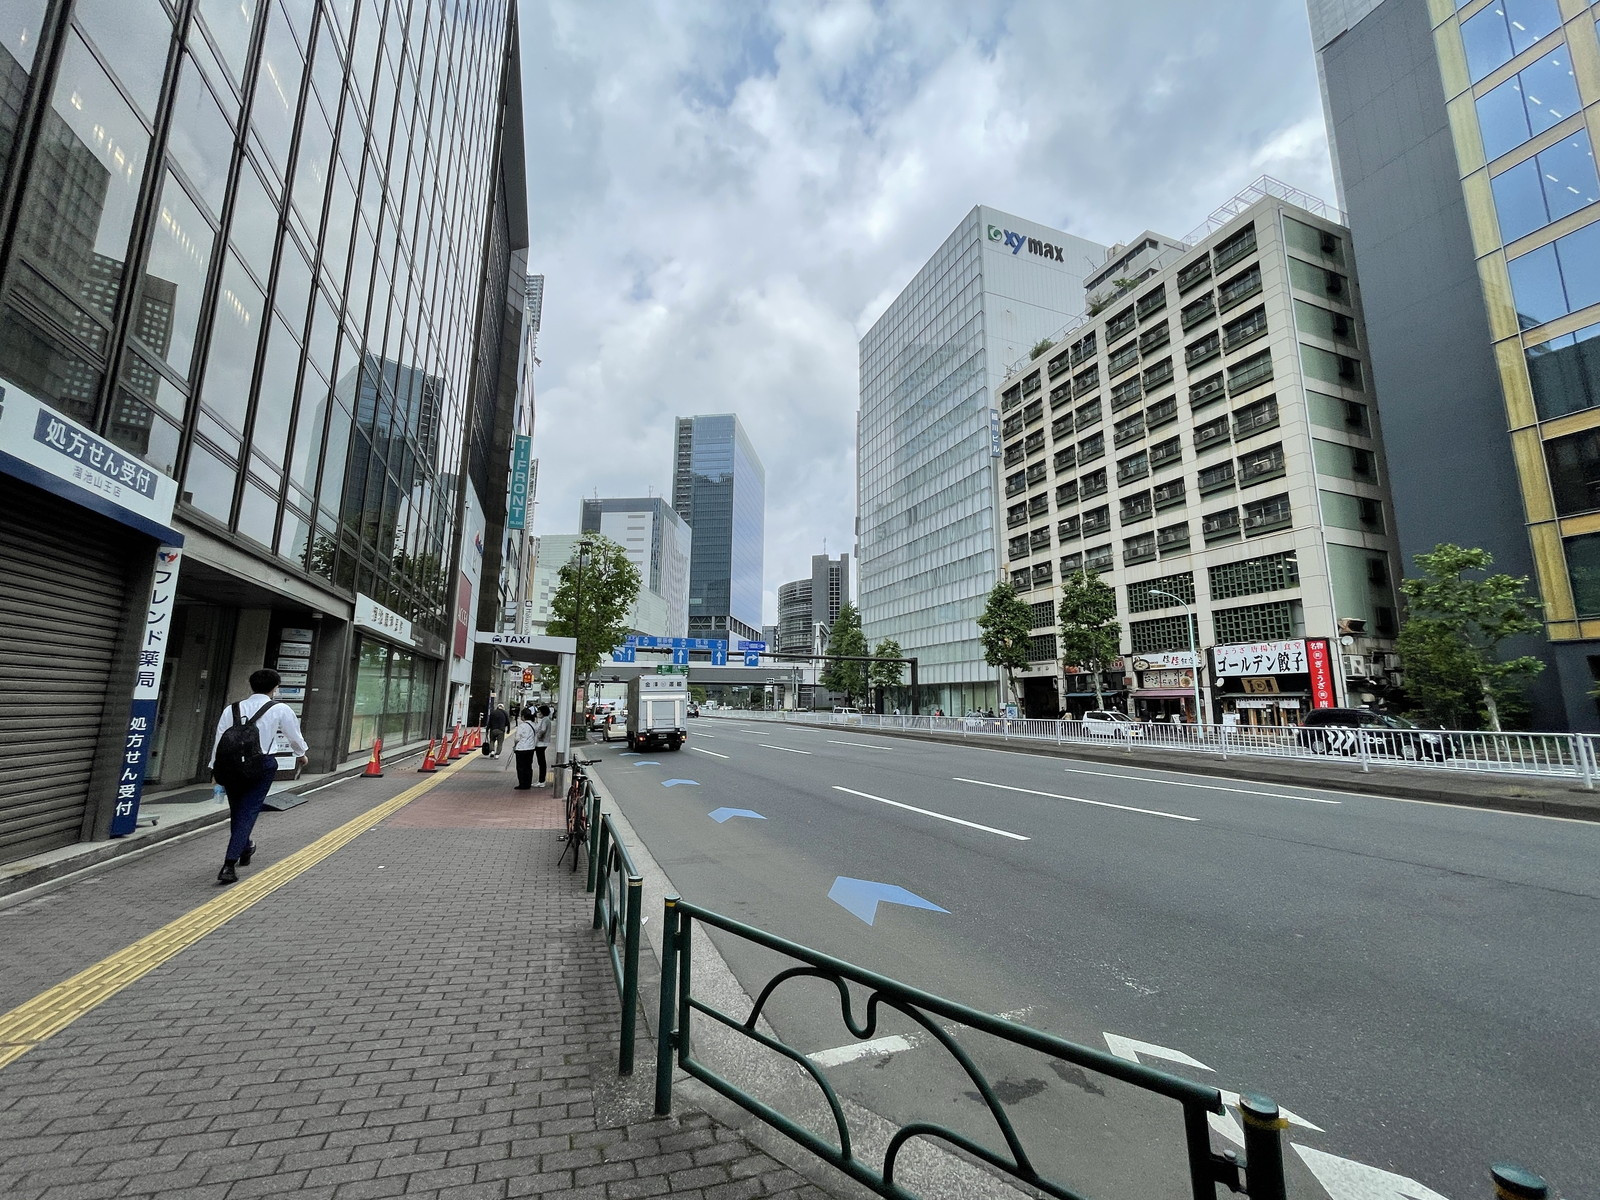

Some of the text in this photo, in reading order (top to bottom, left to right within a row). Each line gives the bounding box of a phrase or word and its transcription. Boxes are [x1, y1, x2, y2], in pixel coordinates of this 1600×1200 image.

[45, 418, 151, 493] 処方せん受付
[72, 465, 122, 499] 溜池山王店
[512, 438, 529, 518] TIFRONT
[135, 570, 172, 688] フレンド薬局
[504, 635, 531, 644] TAXI
[1310, 642, 1324, 650] 名物
[1217, 651, 1303, 674] ゴールデン餃子
[1314, 660, 1326, 690] ぎょうざ
[115, 716, 147, 817] 処方せん受付
